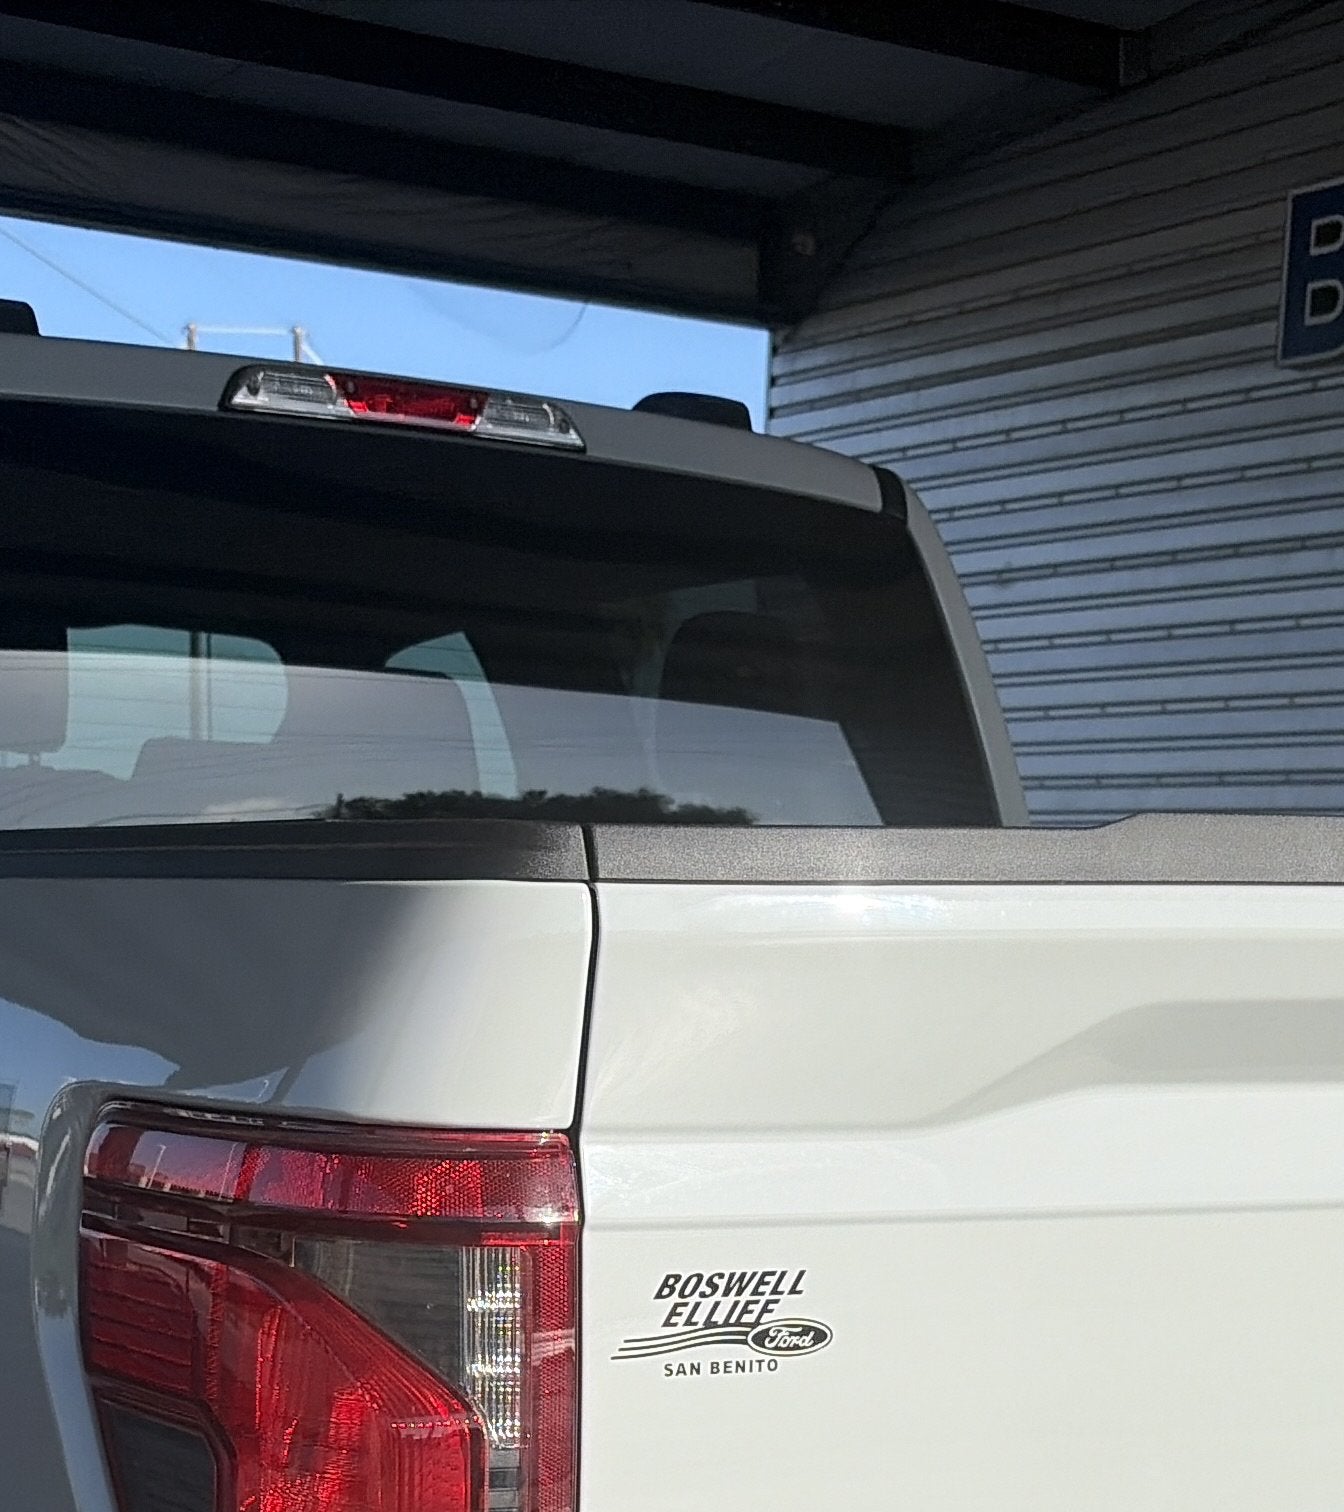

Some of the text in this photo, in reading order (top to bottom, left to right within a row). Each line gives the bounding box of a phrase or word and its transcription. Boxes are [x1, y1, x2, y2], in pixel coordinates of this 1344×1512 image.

[653, 1269, 807, 1300] BOSWELL
[663, 1358, 779, 1377] SAN BENITO
